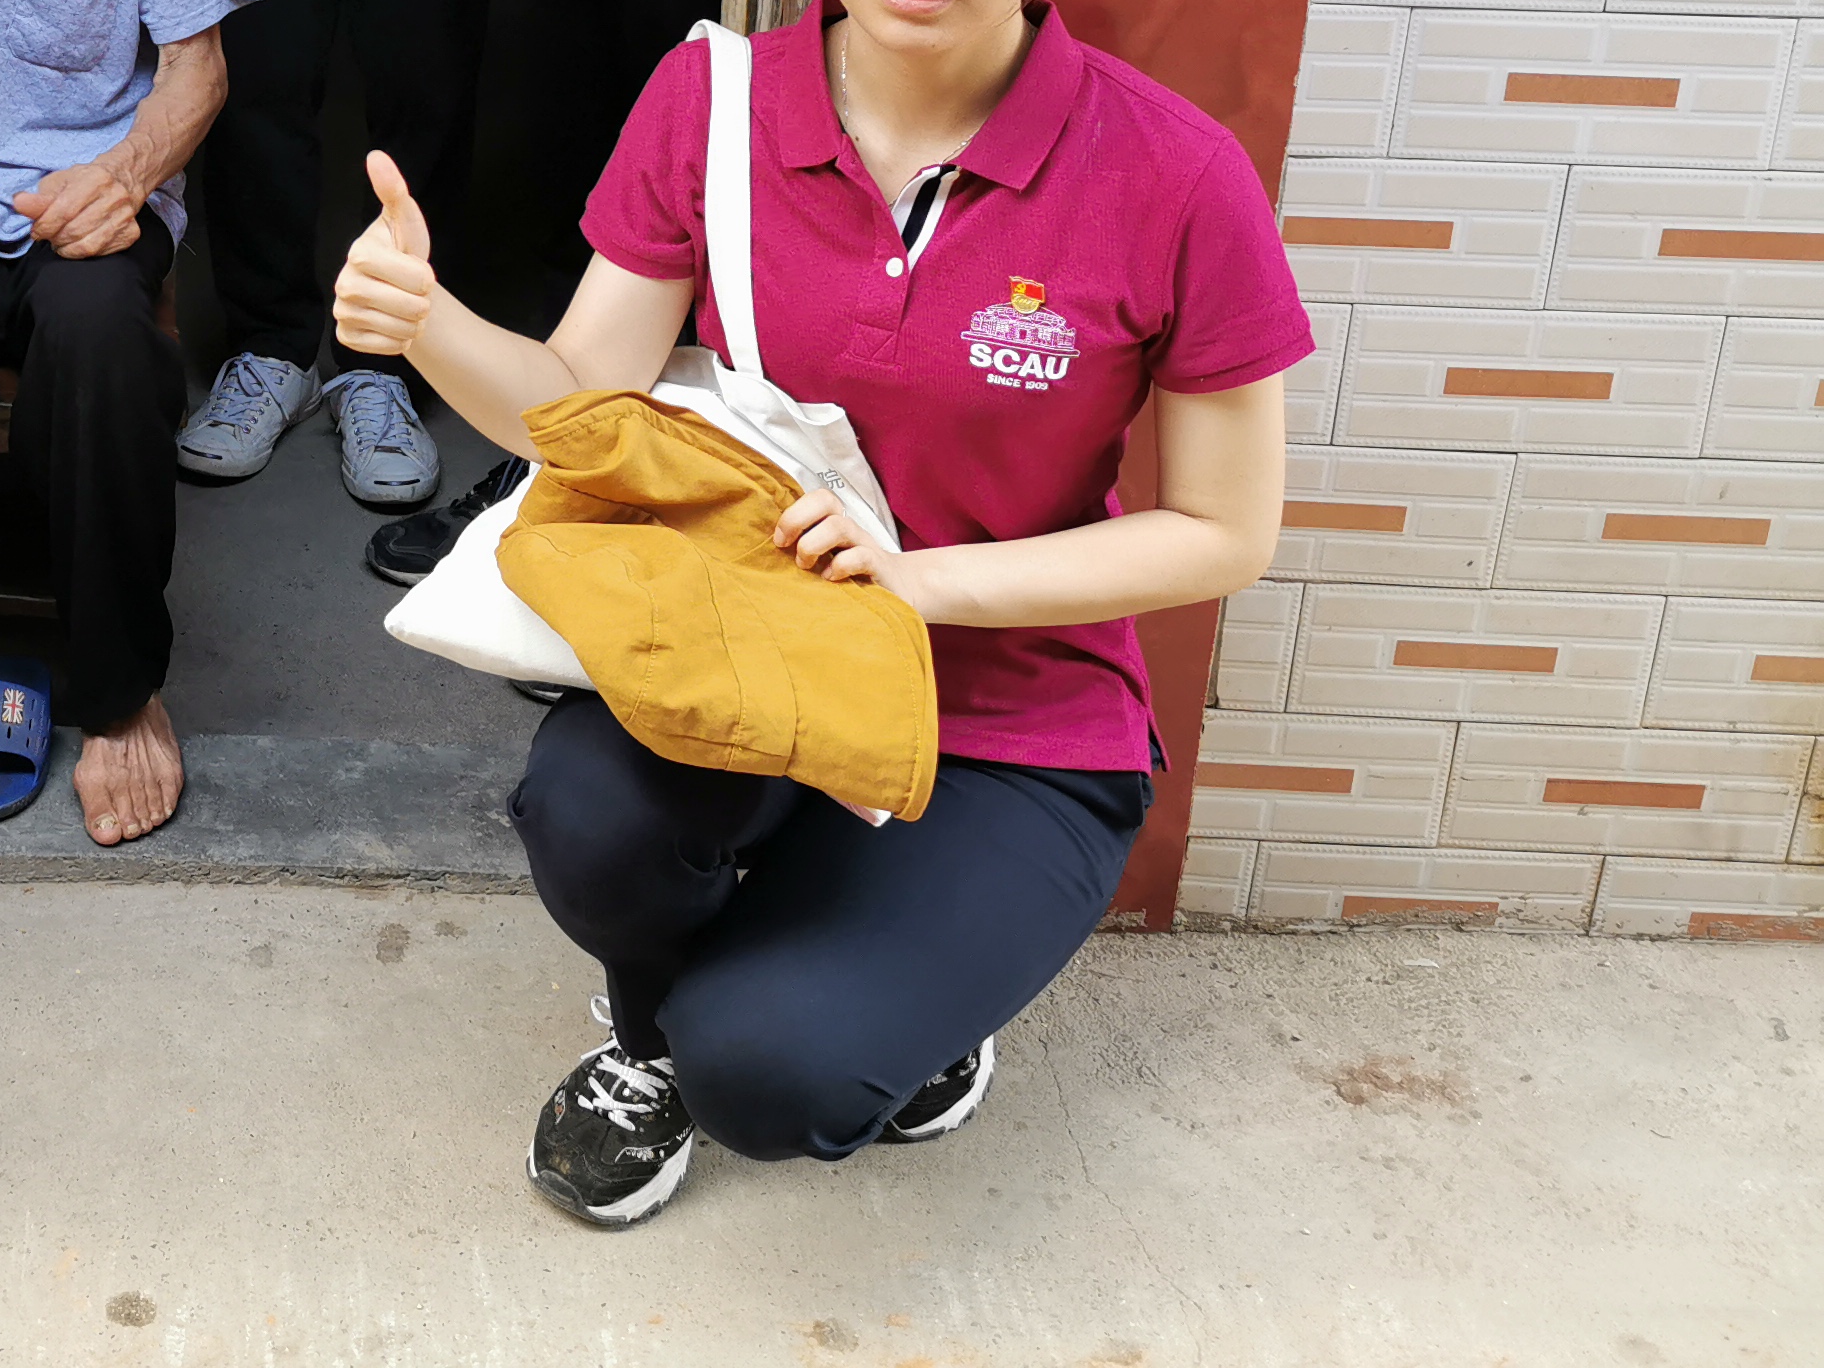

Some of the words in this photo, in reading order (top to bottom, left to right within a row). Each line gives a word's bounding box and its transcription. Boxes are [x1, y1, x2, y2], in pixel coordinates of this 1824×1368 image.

[969, 343, 1071, 380] SCAU
[987, 373, 1022, 387] SINCE
[1025, 379, 1049, 390] 1909
